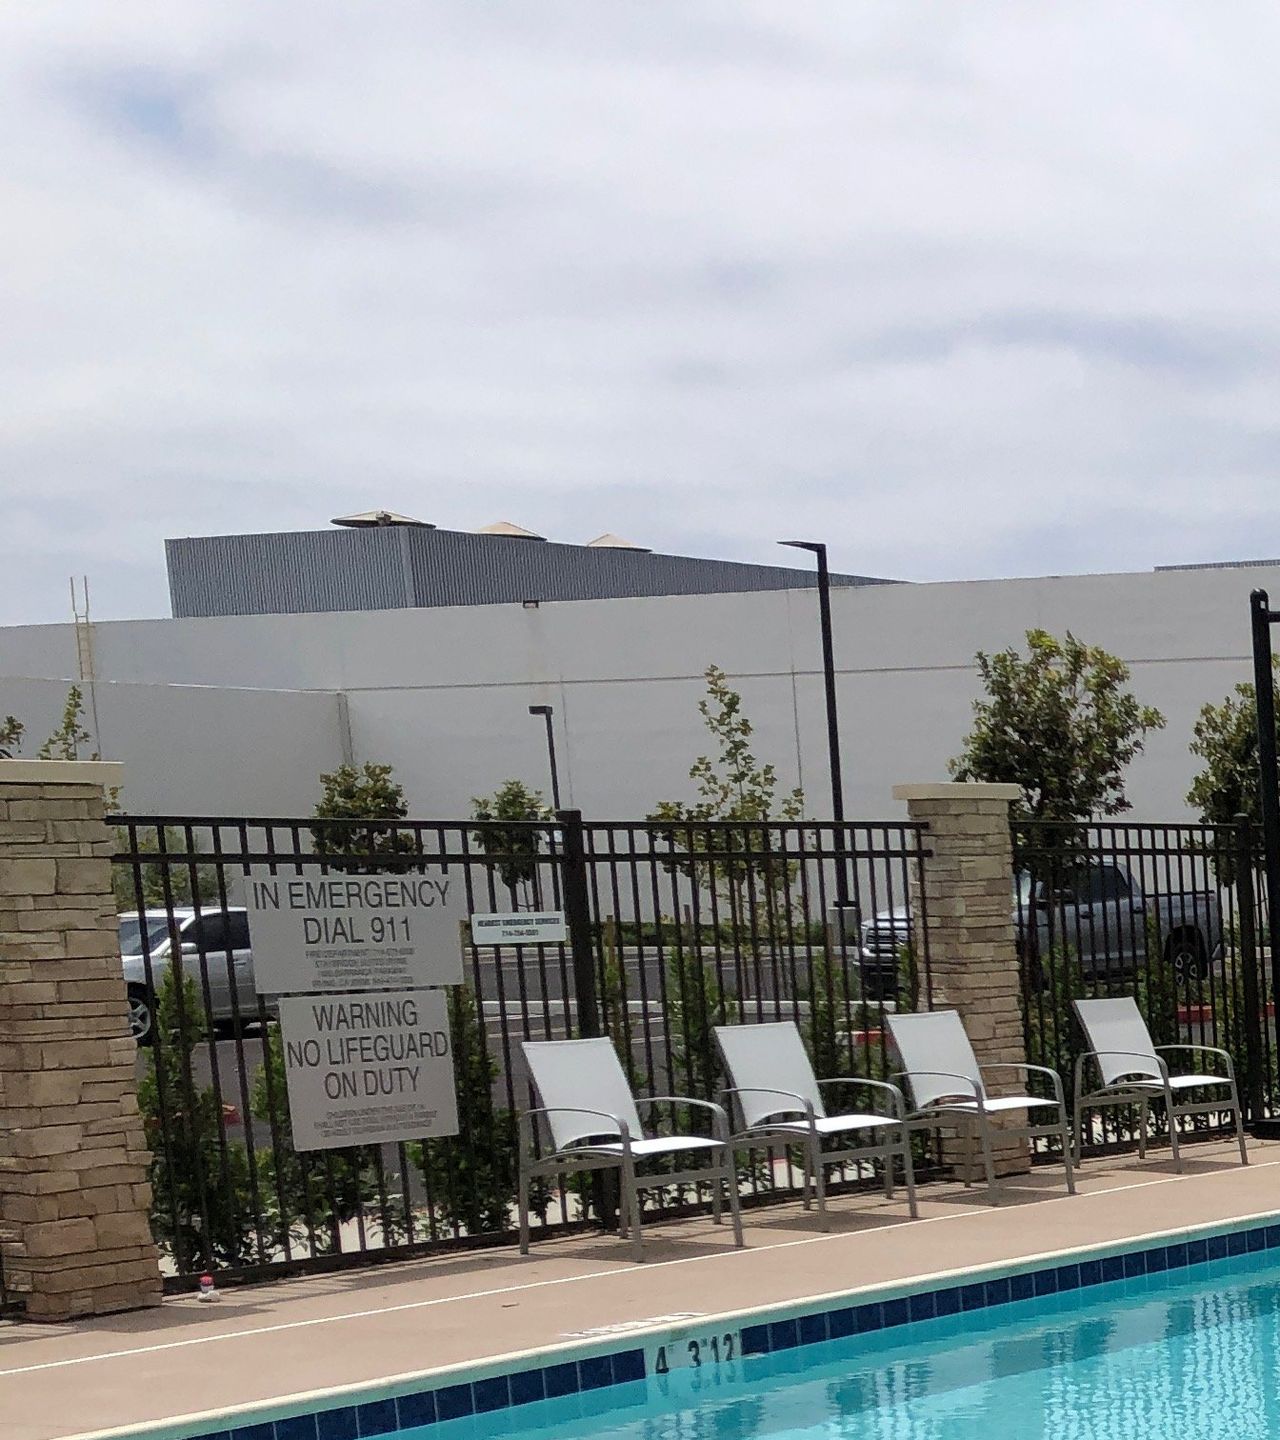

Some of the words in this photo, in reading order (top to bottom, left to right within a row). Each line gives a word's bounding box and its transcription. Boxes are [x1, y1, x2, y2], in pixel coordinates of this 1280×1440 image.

[253, 881, 280, 910] IN
[287, 880, 449, 909] EMERGENCY
[303, 916, 365, 945] DIAL
[370, 916, 411, 943] 911
[312, 999, 418, 1032] WARNING
[287, 1039, 321, 1068] NO
[326, 1031, 449, 1065] LIFEGUARD
[324, 1071, 357, 1100] ON
[363, 1066, 419, 1096] DUTY
[656, 1346, 670, 1374] 4
[687, 1340, 701, 1368] 3
